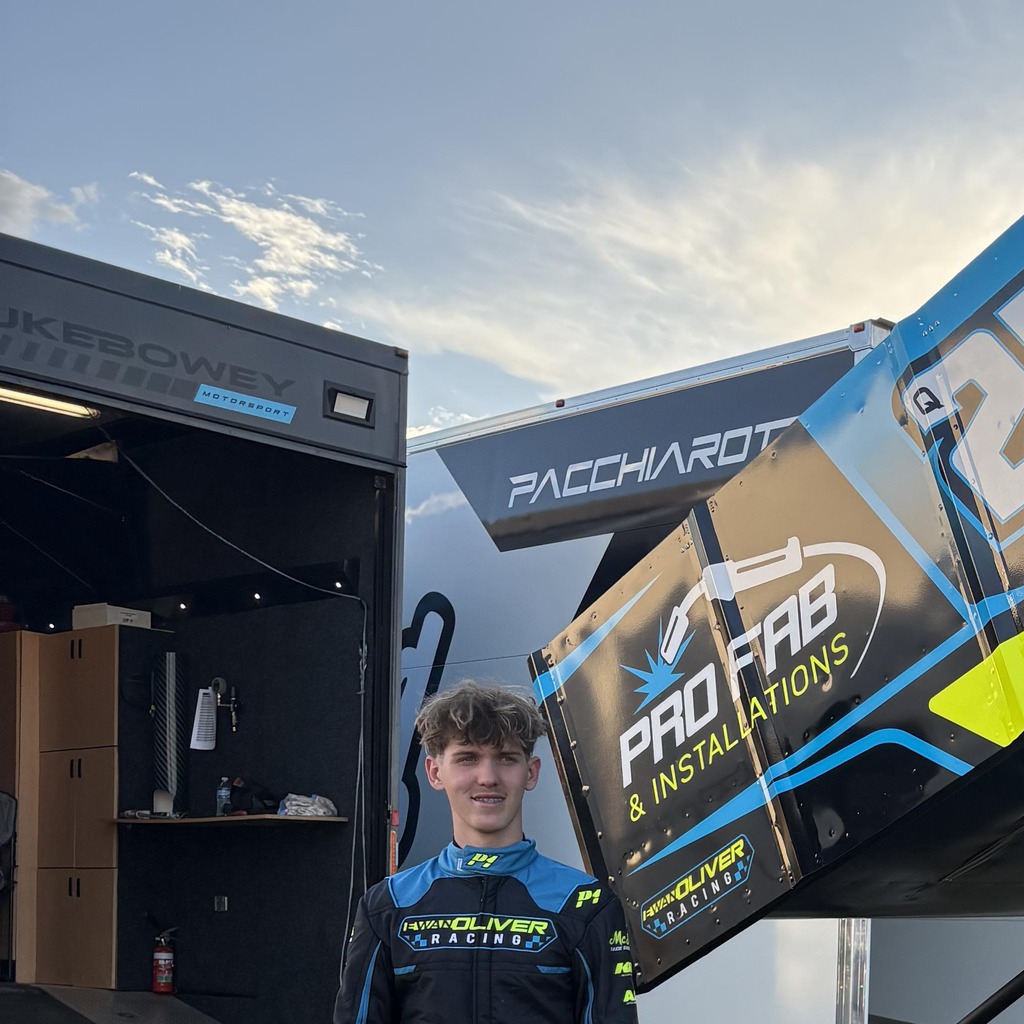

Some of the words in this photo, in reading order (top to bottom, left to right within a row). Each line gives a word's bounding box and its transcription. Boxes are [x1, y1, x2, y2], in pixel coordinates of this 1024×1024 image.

[201, 390, 290, 418] MOTORSPORT
[912, 386, 944, 415] Q
[619, 663, 719, 788] PRO
[728, 564, 838, 702] FAB
[629, 793, 646, 823] &
[652, 632, 850, 805] INSTALLATIONS
[467, 853, 498, 868] P1
[575, 889, 601, 908] P1
[666, 872, 732, 925] RACING
[431, 933, 522, 945] RACING
